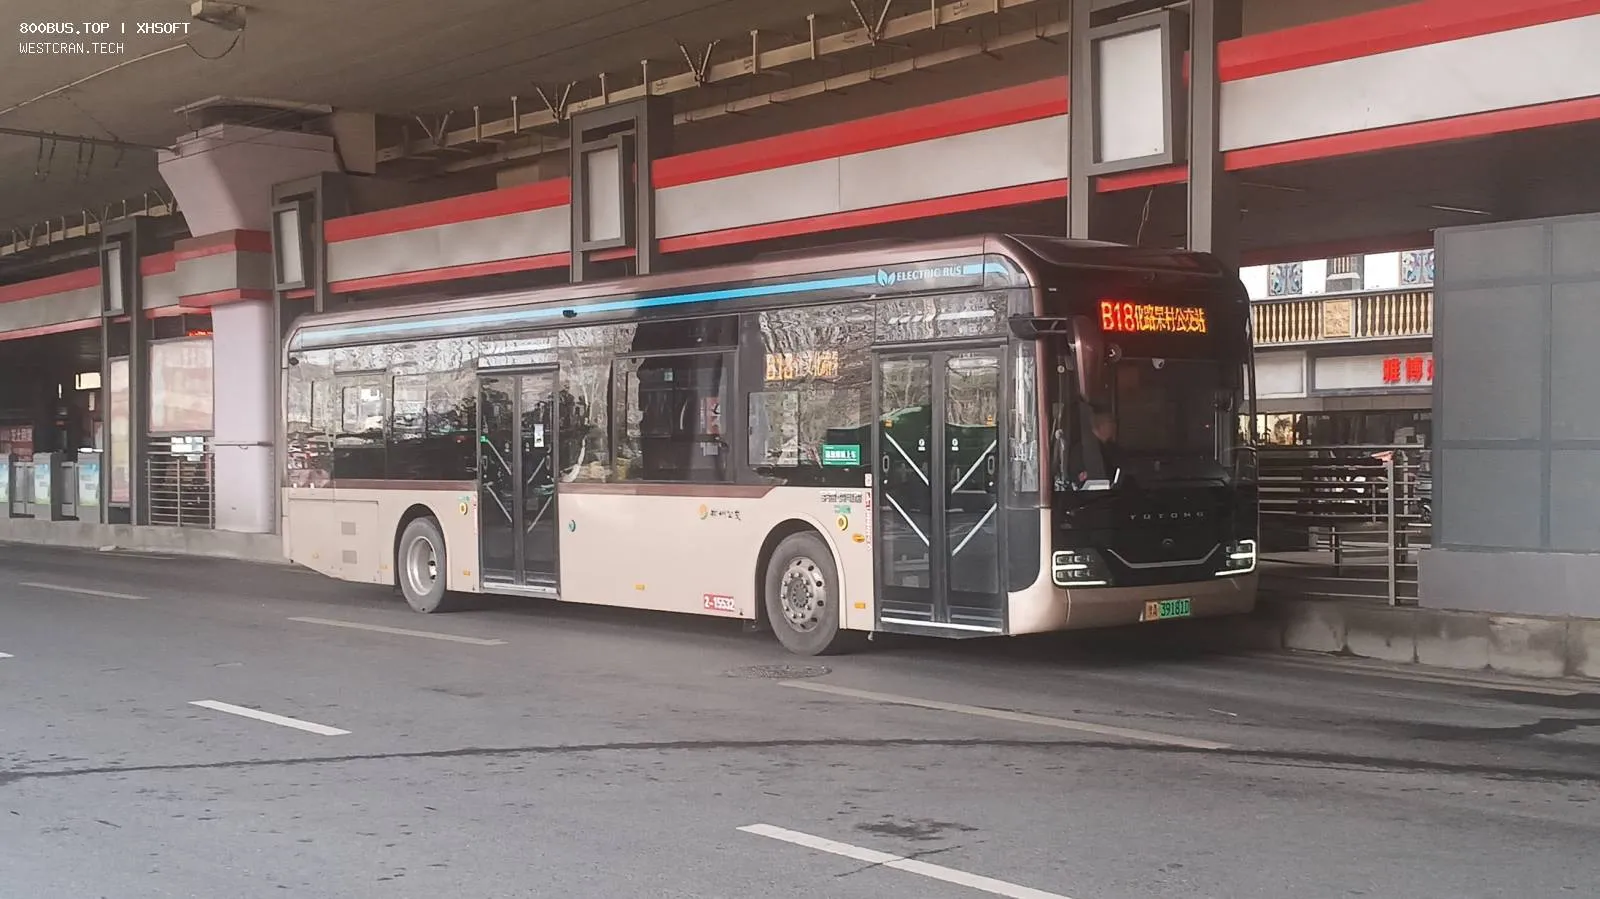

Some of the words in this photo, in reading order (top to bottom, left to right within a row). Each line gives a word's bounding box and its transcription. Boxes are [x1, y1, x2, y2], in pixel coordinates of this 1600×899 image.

[896, 268, 940, 281] ELECTRIC
[943, 265, 961, 277] BUS
[1100, 301, 1135, 331] B18
[1129, 511, 1204, 521] YUTONG
